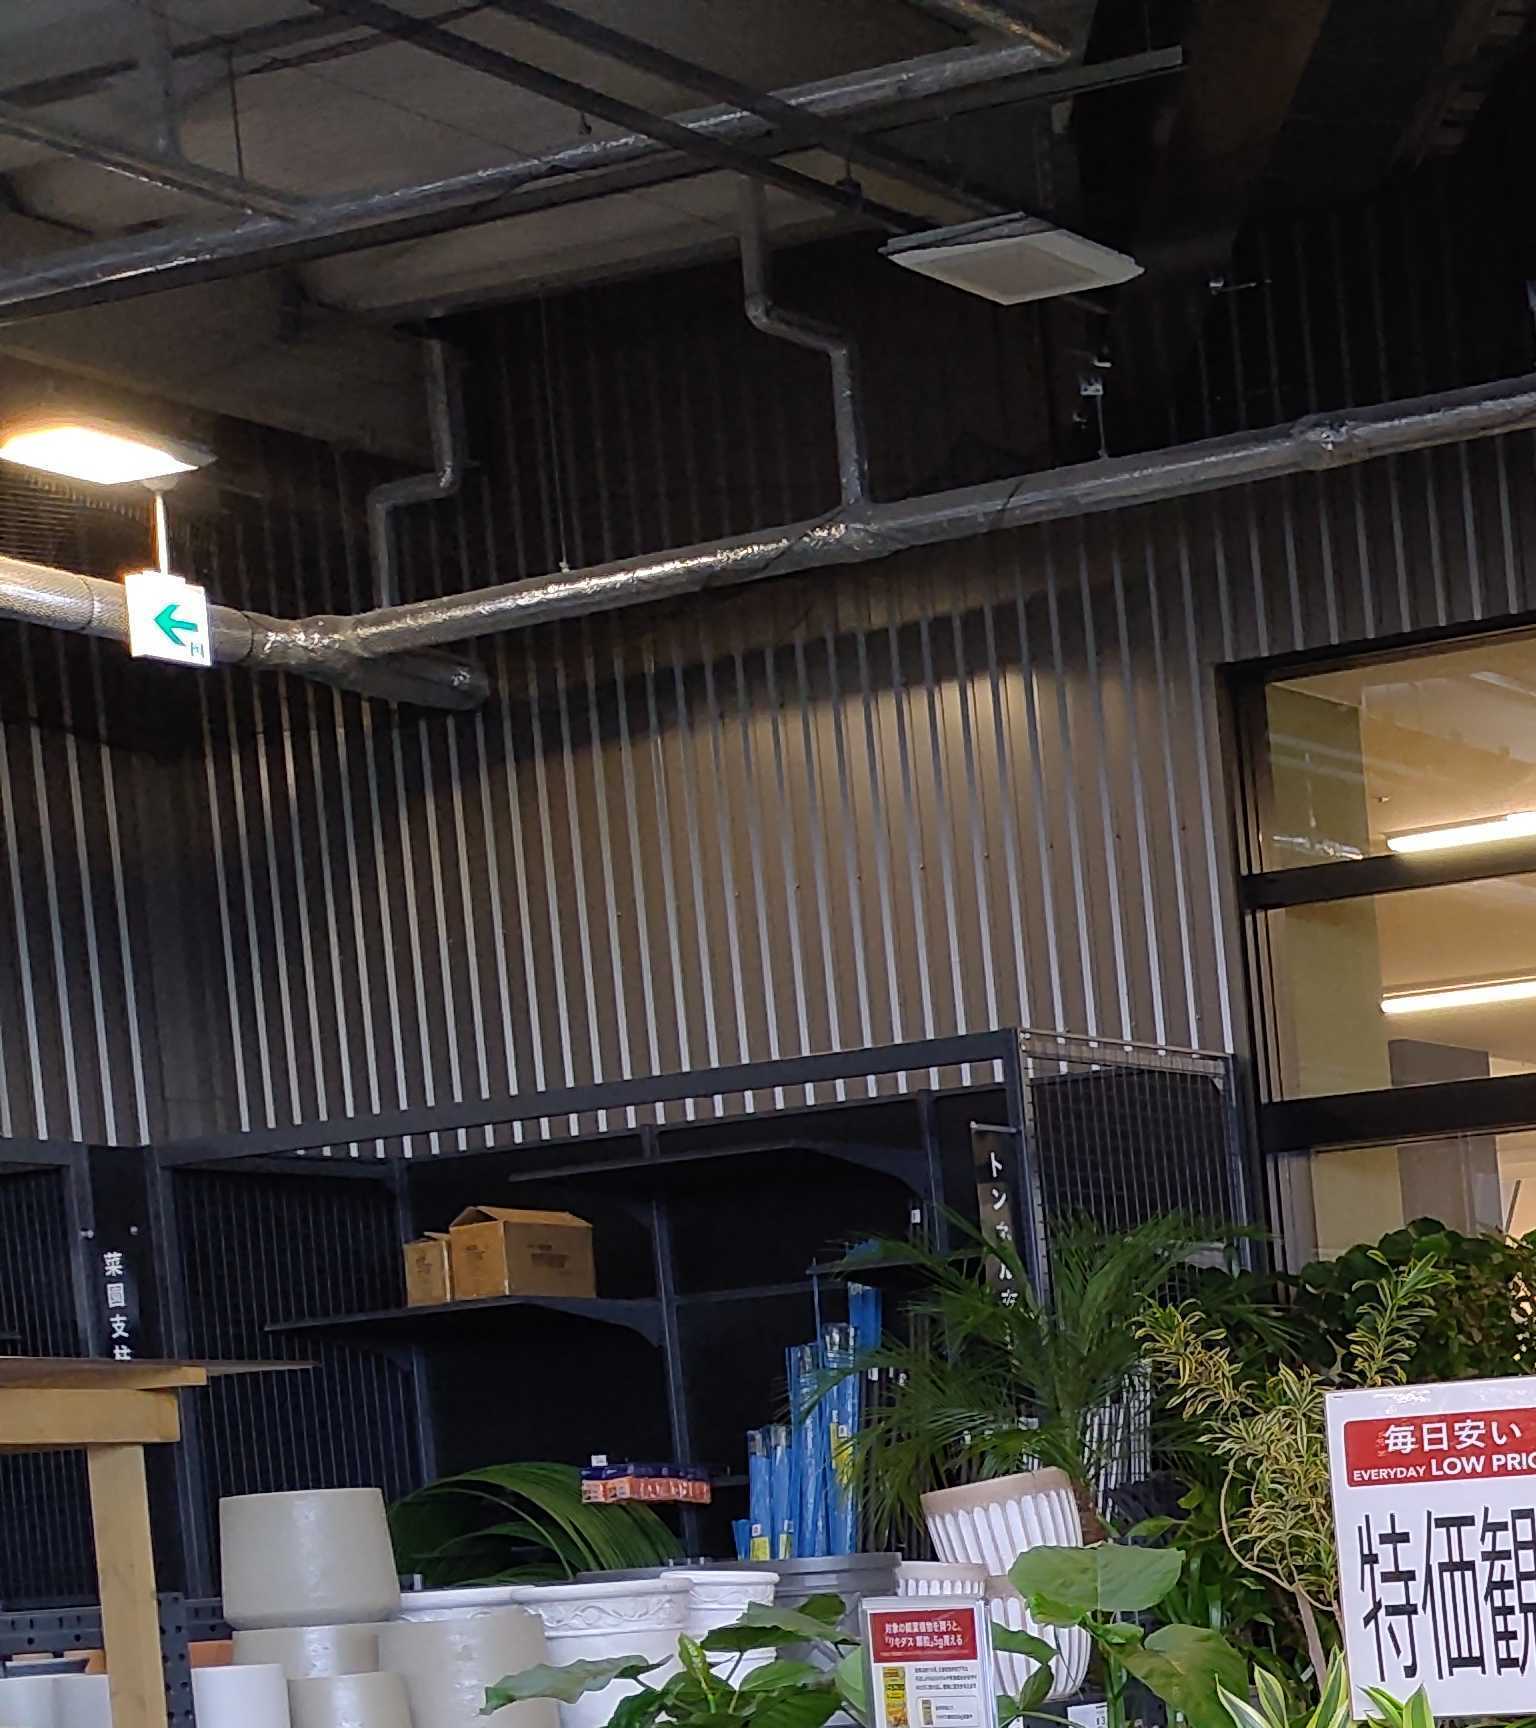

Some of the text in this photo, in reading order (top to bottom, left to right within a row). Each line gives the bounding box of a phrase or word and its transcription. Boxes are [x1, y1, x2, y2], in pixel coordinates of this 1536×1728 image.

[1384, 1418, 1523, 1454] 毎日安い
[1352, 1465, 1427, 1482] EVERYDAY
[1430, 1455, 1486, 1476] LOW
